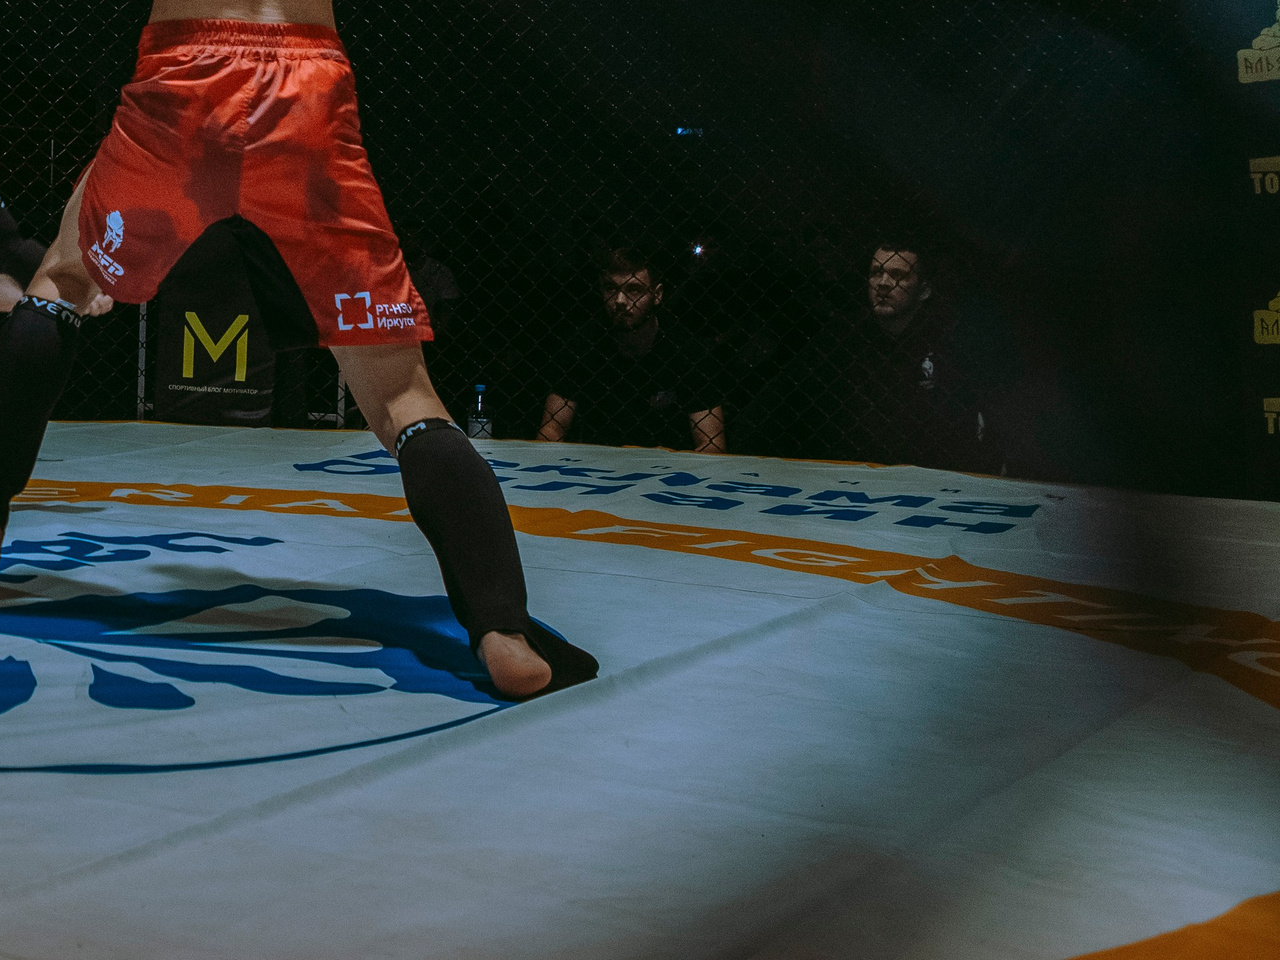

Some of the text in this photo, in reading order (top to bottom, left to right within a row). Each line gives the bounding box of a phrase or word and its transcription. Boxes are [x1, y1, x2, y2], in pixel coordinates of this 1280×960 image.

[376, 317, 416, 330] Иркутск
[168, 384, 259, 395] СПОРТИВНЫЙ БЛОГ МОТИВАТОР
